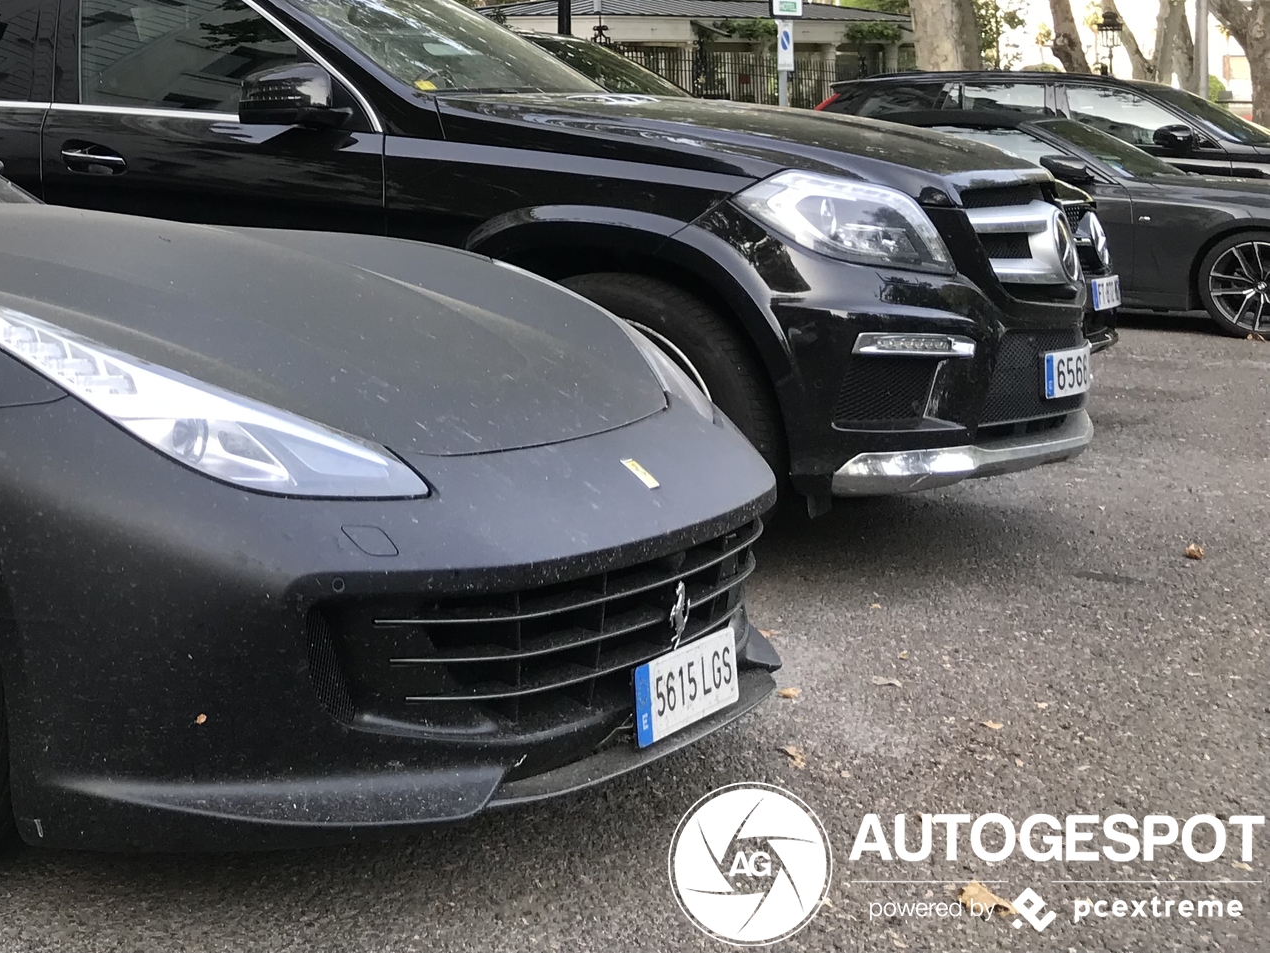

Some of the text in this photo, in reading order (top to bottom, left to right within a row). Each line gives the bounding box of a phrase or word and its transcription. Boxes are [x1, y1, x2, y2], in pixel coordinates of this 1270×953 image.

[779, 2, 796, 11] HOTEL
[655, 646, 732, 717] 5615 LGS
